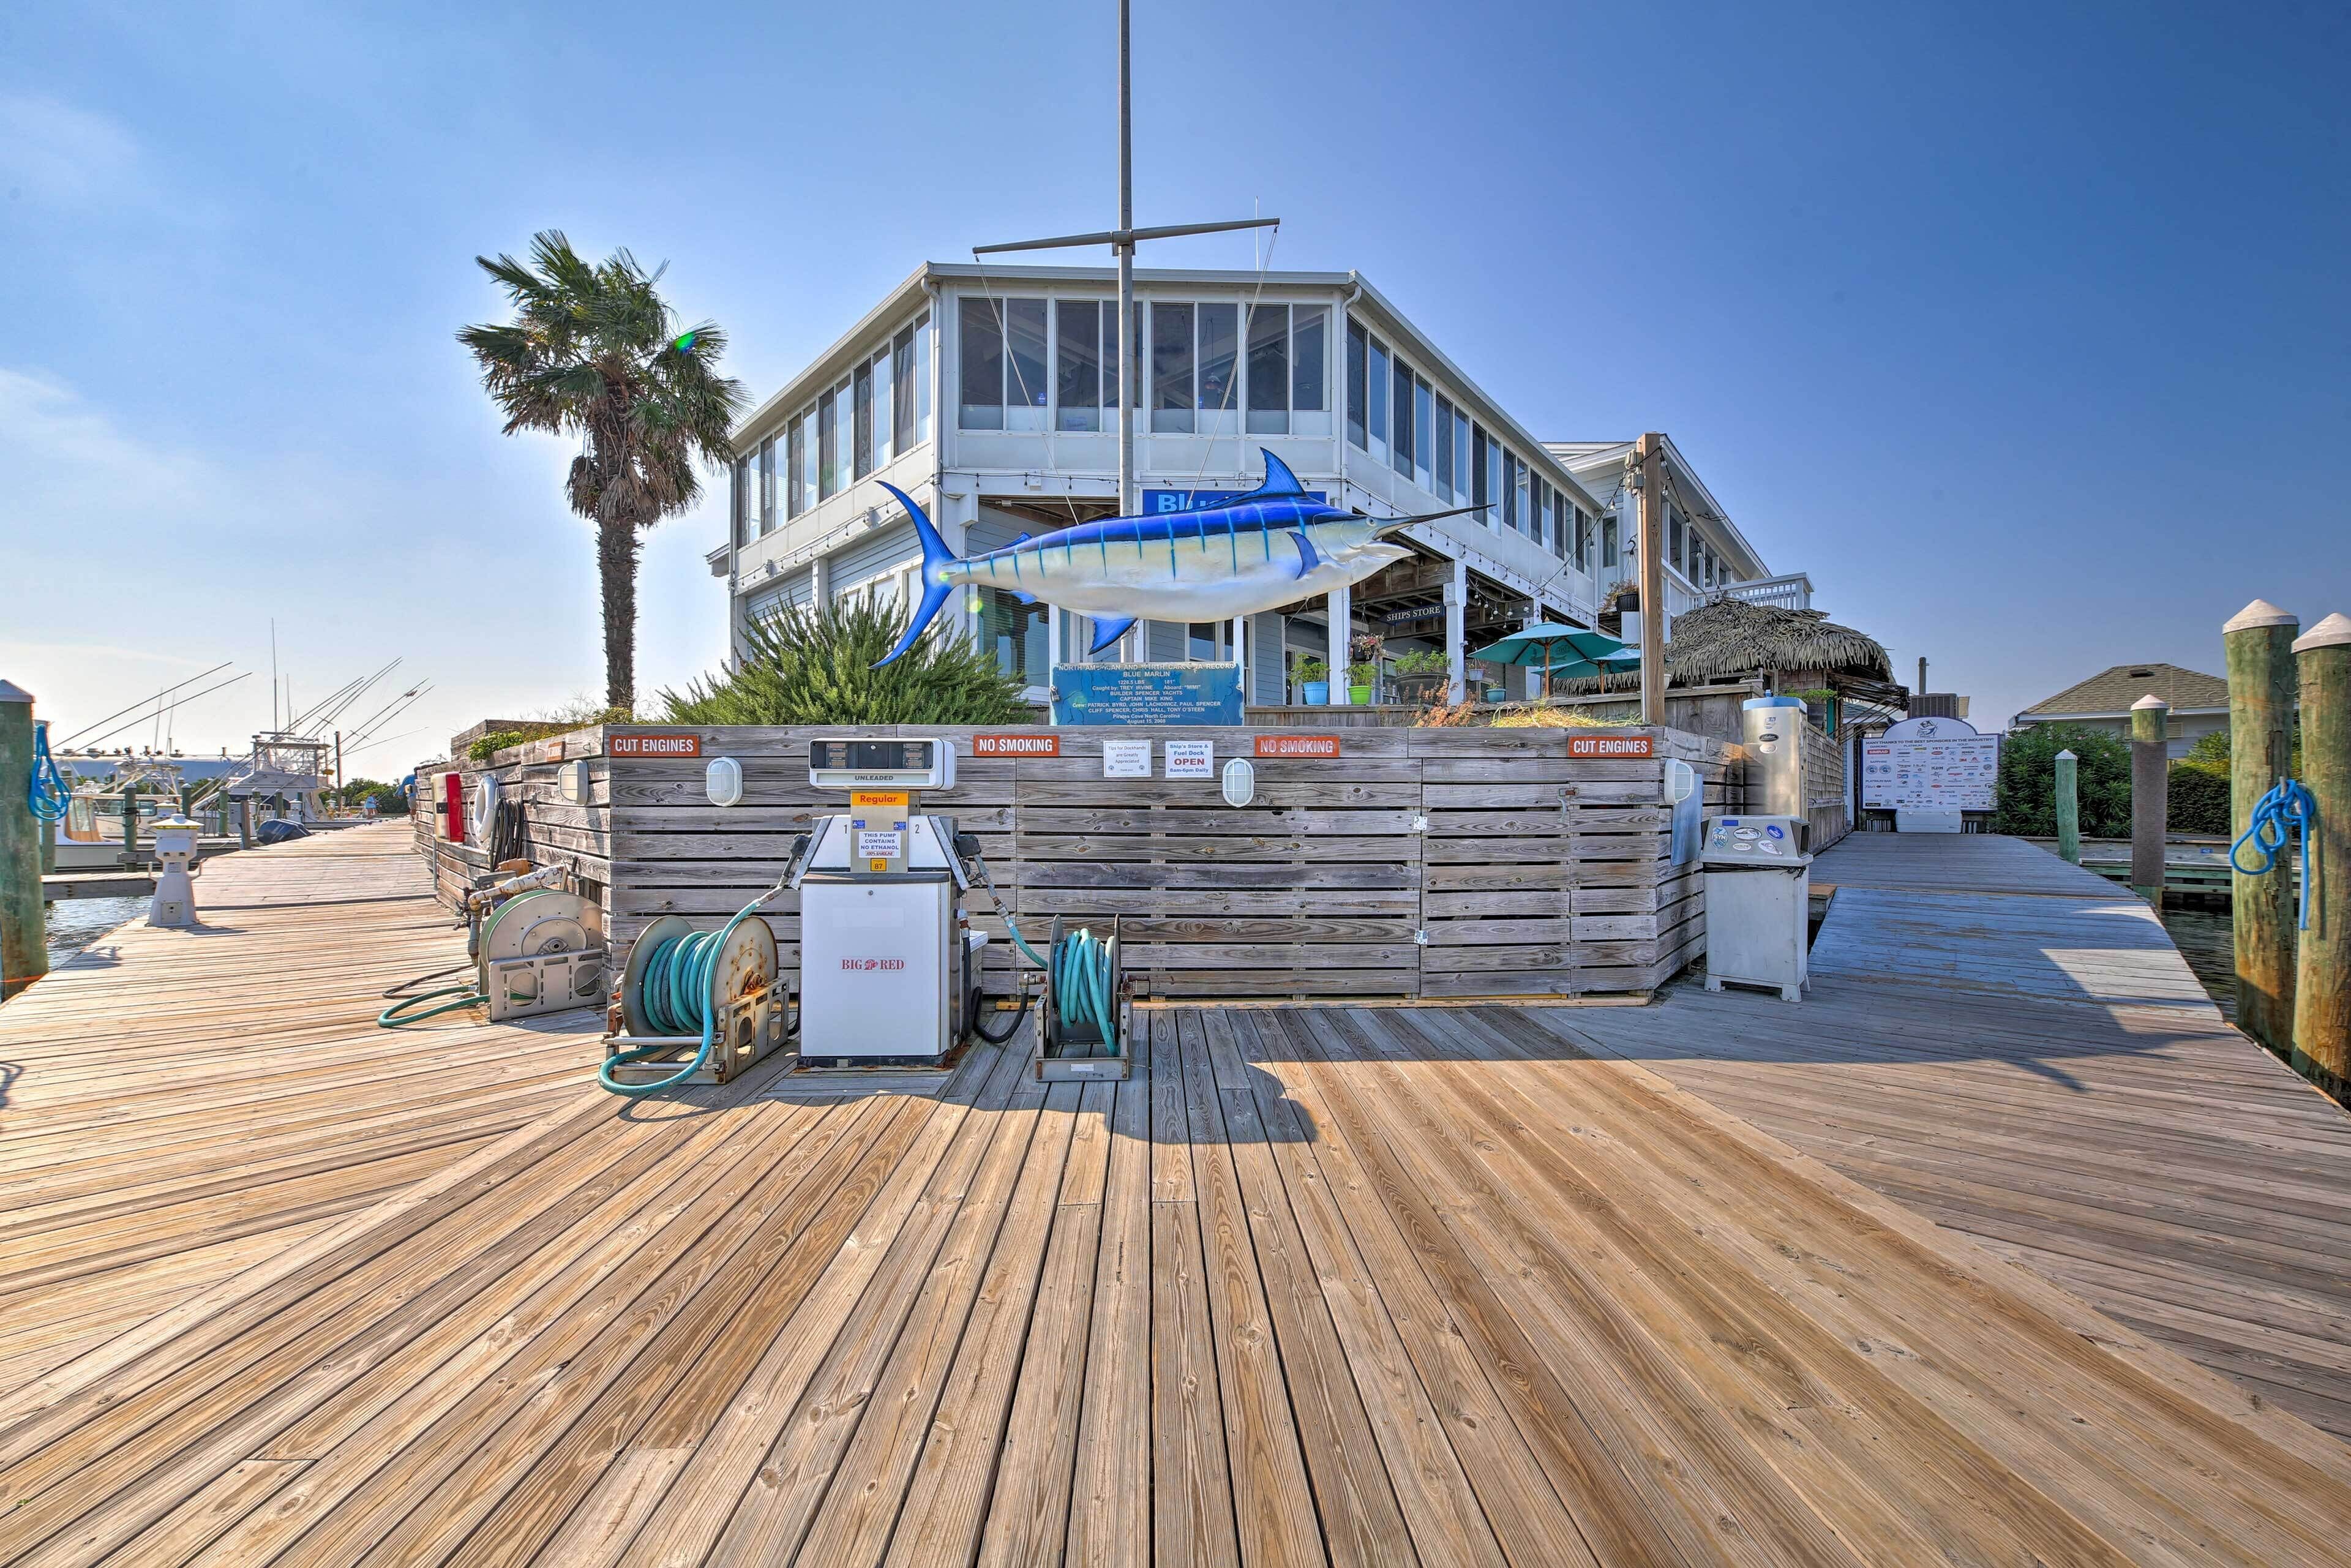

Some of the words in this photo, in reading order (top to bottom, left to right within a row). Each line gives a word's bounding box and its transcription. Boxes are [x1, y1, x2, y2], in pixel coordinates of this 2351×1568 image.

[1158, 494, 1220, 512] Blu
[1387, 610, 1411, 622] SHIPS
[1412, 606, 1441, 618] STORE
[615, 739, 638, 752] CUT
[643, 739, 694, 752] ENGINES
[980, 739, 995, 752] NO
[999, 738, 1052, 752] SMOKING
[1260, 740, 1277, 752] NO
[1280, 740, 1333, 753] SMOKING
[1573, 740, 1596, 753] CUT
[1599, 740, 1648, 754] ENGINES
[860, 795, 898, 805] Regular
[844, 824, 847, 834] 1
[915, 824, 920, 834] 2
[842, 959, 862, 970] BIG
[880, 959, 904, 970] RED
